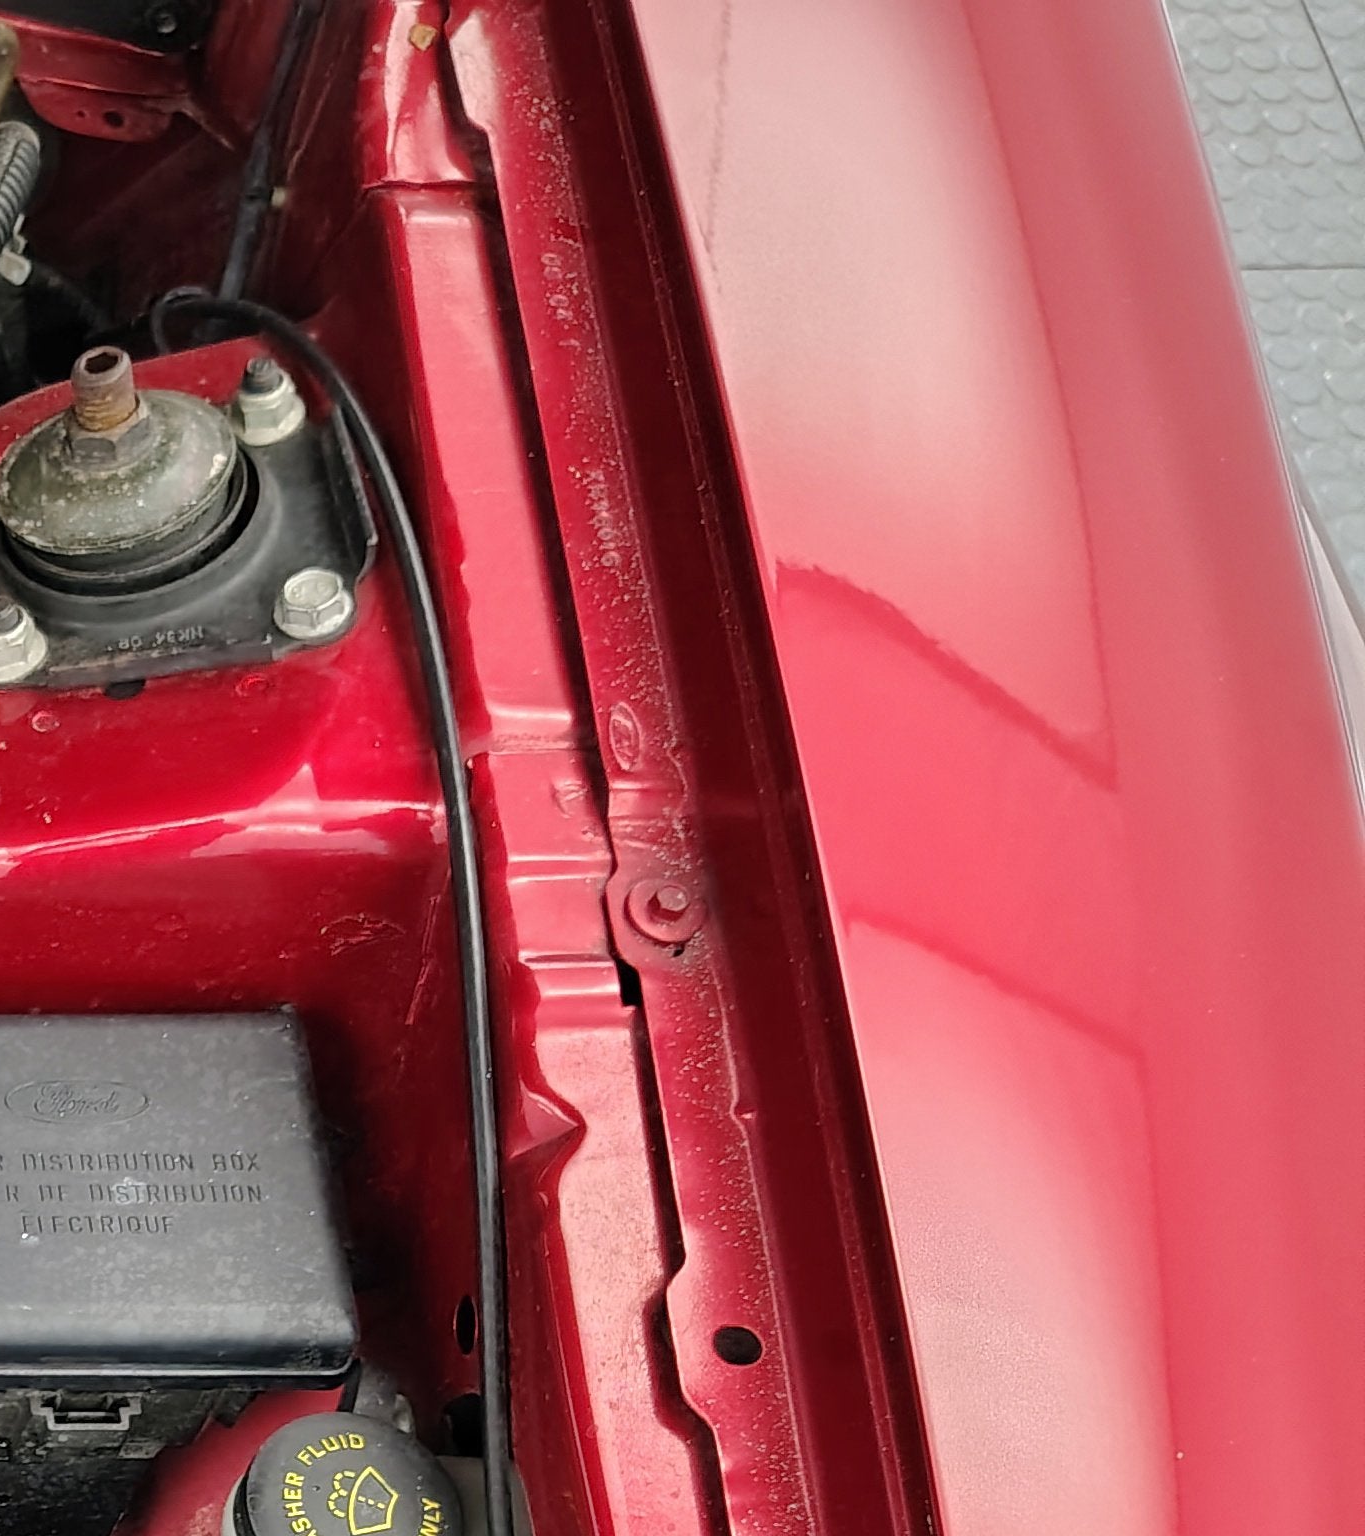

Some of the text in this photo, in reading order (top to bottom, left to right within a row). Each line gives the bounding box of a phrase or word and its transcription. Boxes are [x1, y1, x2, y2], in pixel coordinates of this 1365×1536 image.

[22, 1153, 195, 1172] DISTRIBUTION
[212, 1153, 261, 1172] BOX
[39, 1184, 70, 1202] DE
[88, 1184, 263, 1203] DISTRIBUTION
[297, 1432, 365, 1467] FLUID
